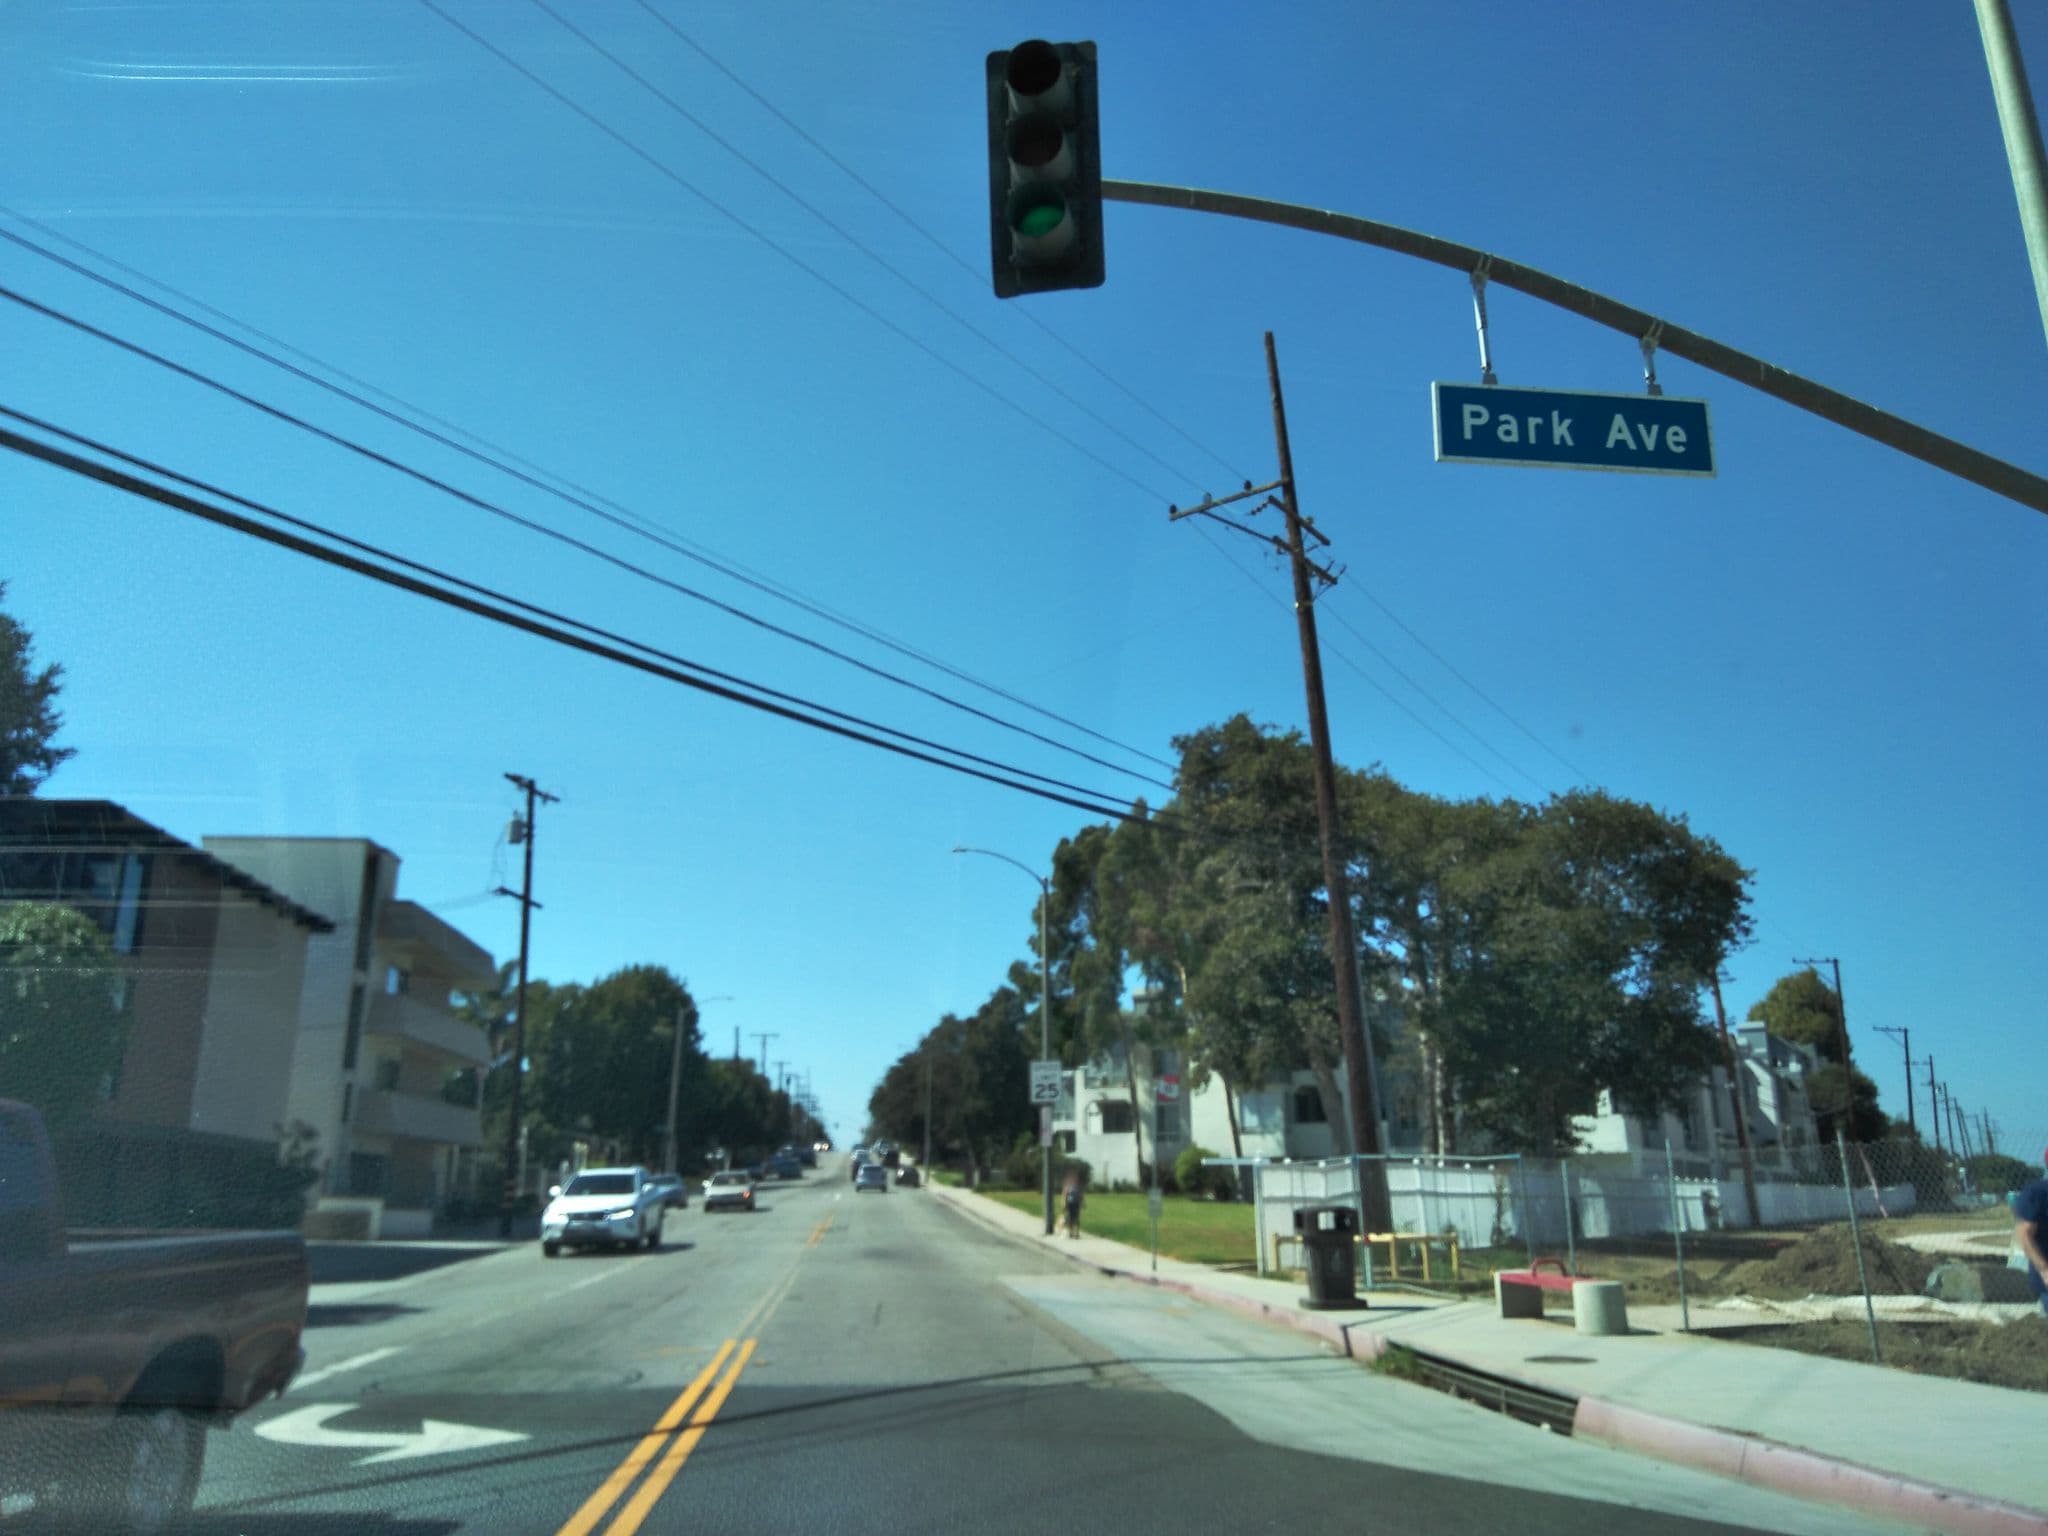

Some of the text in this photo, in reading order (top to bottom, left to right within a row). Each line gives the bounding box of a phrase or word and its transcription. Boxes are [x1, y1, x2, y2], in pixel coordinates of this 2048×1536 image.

[1462, 403, 1688, 454] Park Ave
[1035, 1083, 1060, 1099] 25
